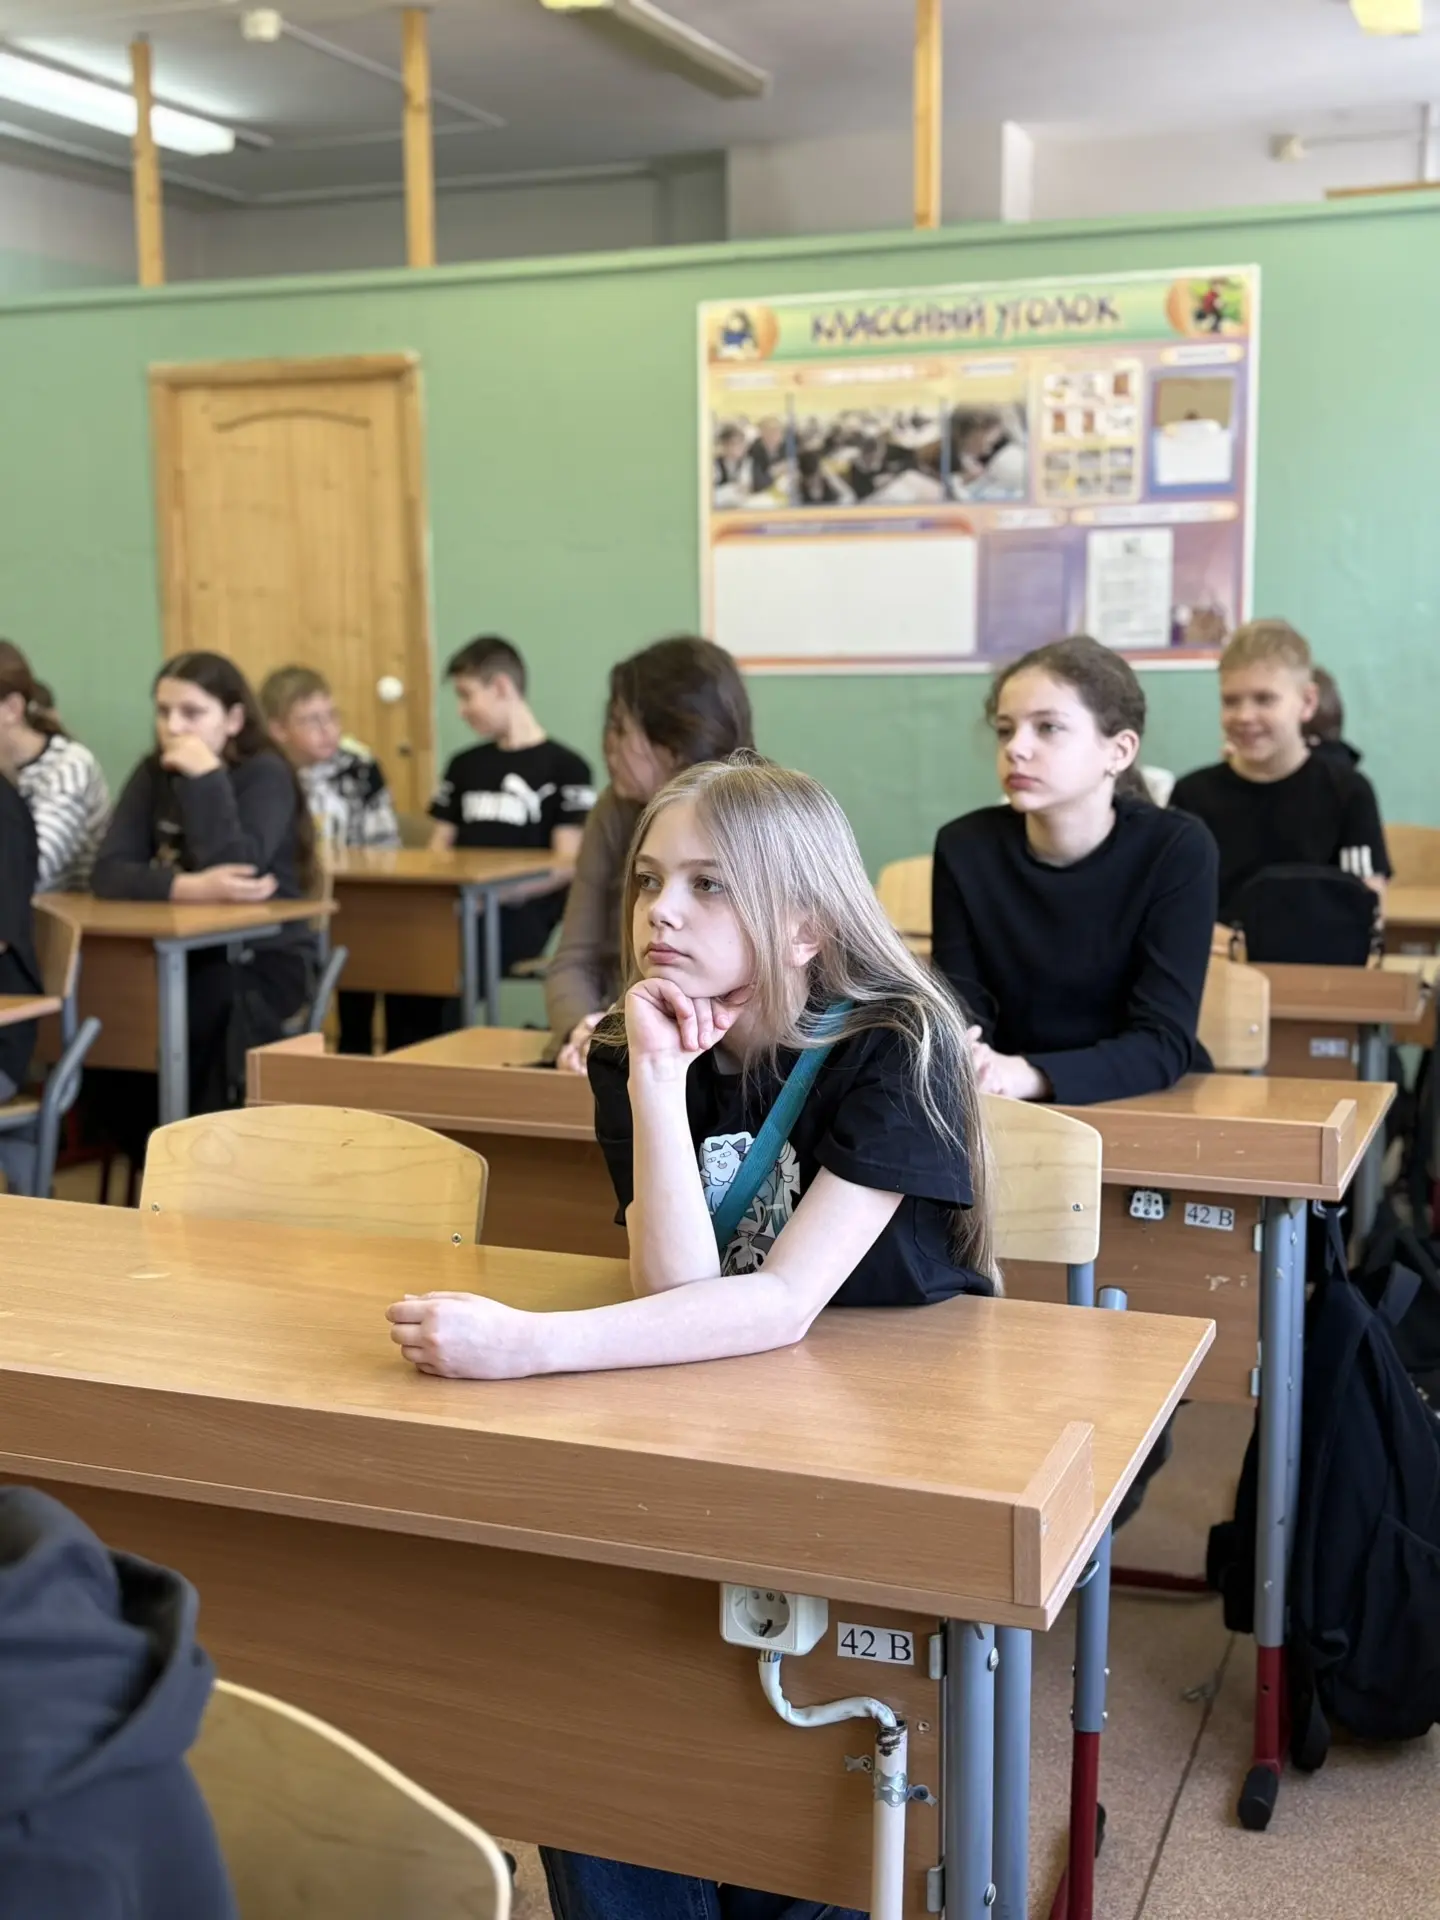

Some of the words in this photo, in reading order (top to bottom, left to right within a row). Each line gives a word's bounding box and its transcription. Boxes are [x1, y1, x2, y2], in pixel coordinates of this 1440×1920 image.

[811, 299, 987, 341] КЛАССНЫЙ
[996, 293, 1120, 336] УГОЛОК
[1187, 1205, 1210, 1224] 42
[841, 1628, 877, 1658] 42
